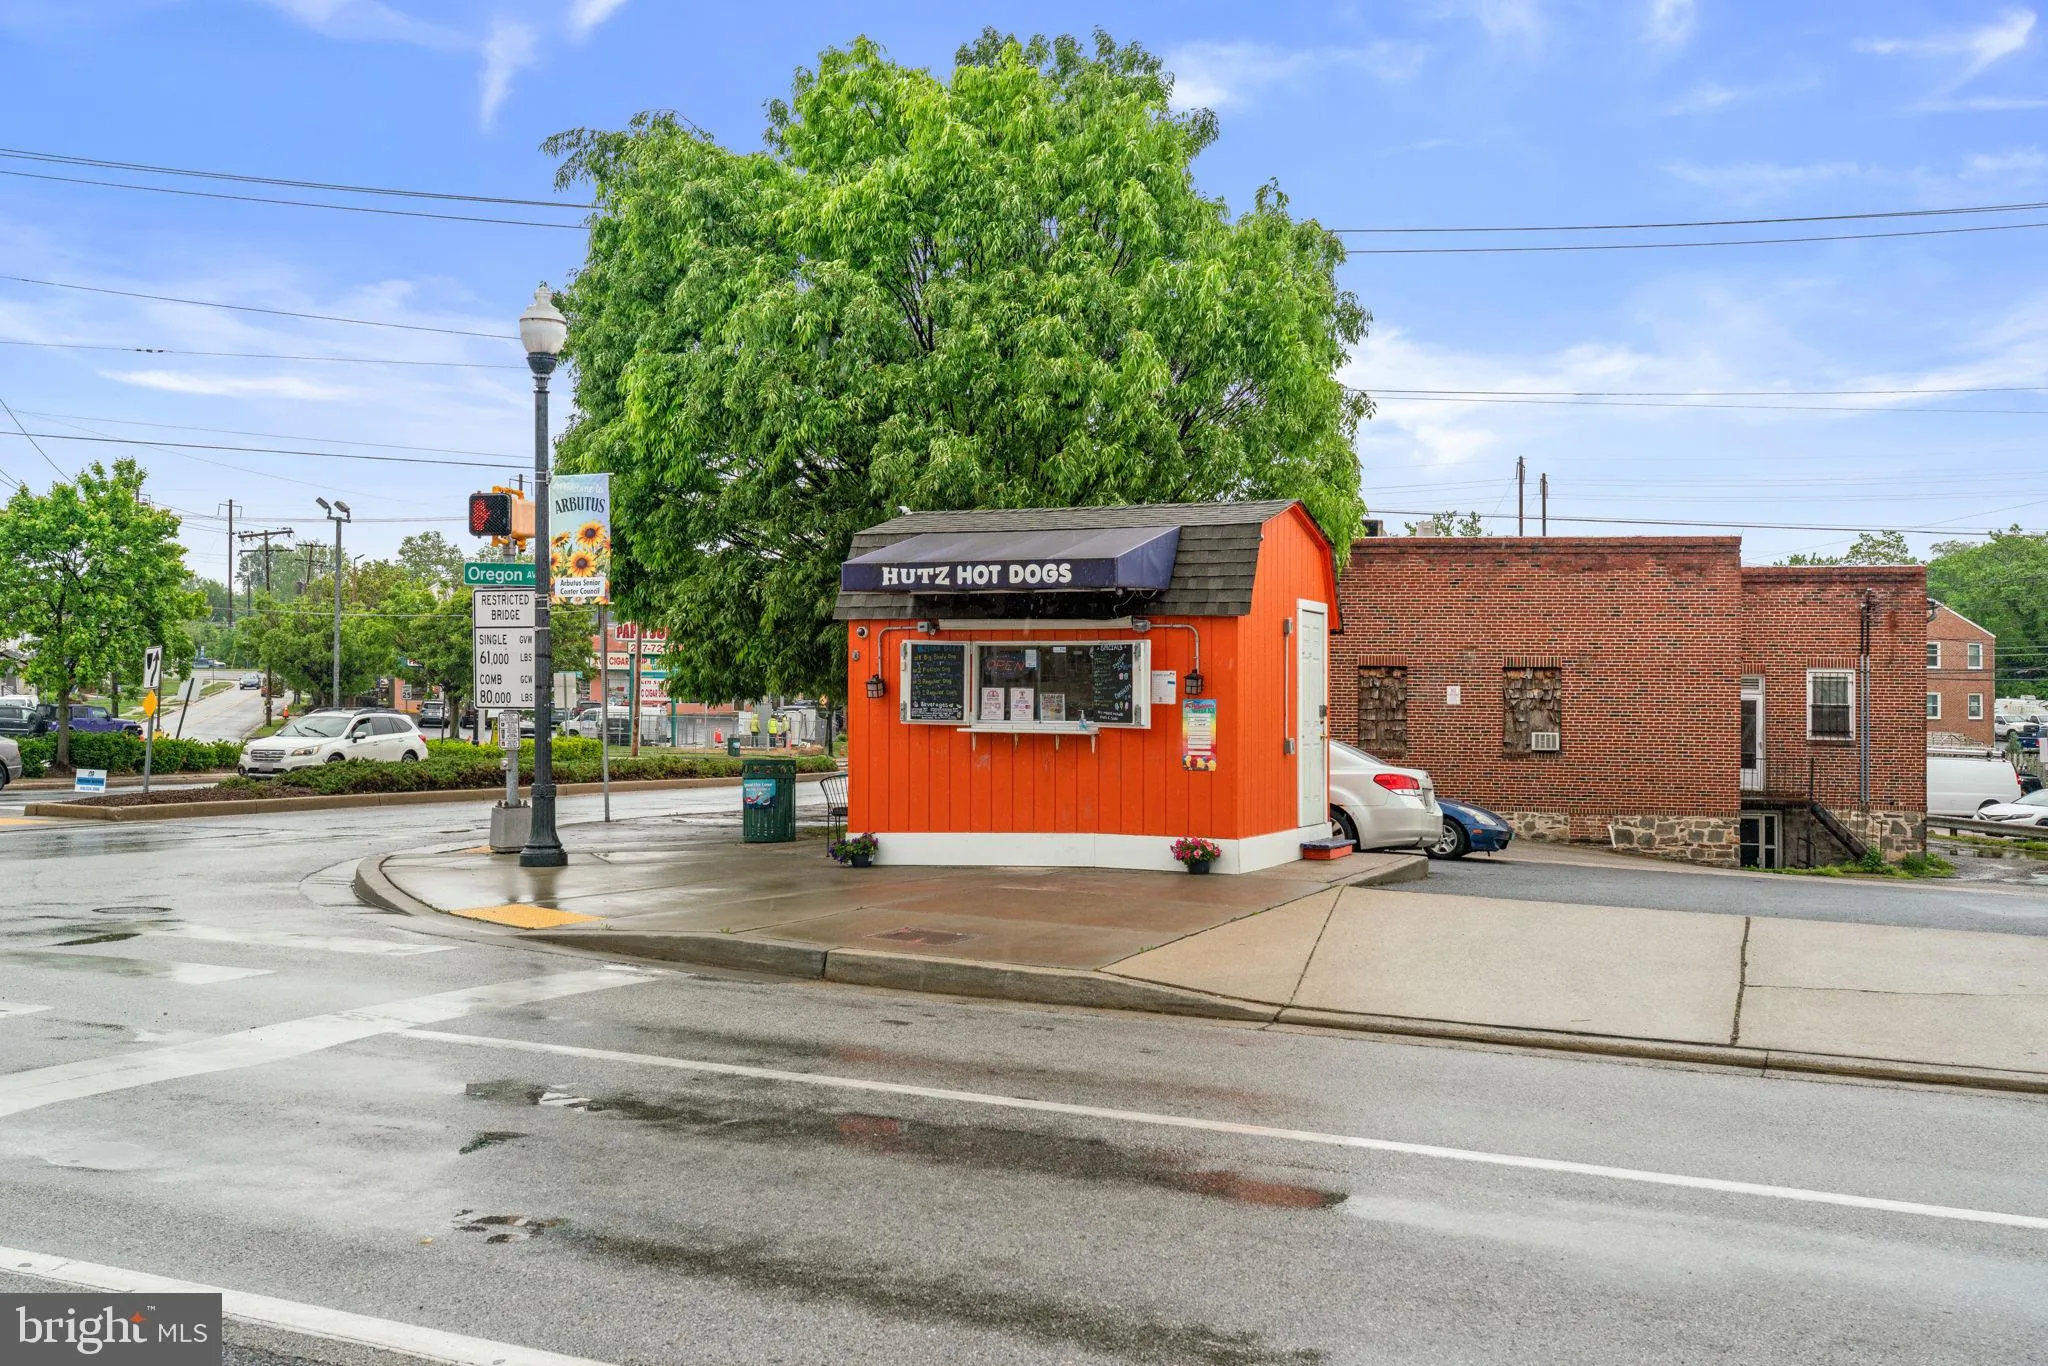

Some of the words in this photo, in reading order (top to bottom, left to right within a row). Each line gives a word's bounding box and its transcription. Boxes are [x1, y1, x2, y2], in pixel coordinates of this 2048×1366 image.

[555, 496, 606, 514] ARBUTUS
[468, 566, 523, 584] Oregon
[882, 566, 950, 586] HUTZ
[957, 565, 1002, 585] HOT
[1009, 563, 1072, 584] DOGS
[580, 587, 600, 595] Council
[481, 594, 530, 606] RESTRICTED
[491, 610, 520, 620] BRIDGE
[616, 624, 648, 638] PAP
[480, 634, 508, 645] SINGLE
[520, 636, 532, 644] GVW
[480, 650, 510, 666] 61,000
[520, 653, 532, 662] LBS
[608, 656, 629, 666] CIGAR
[986, 660, 1024, 671] OPEN
[480, 674, 502, 684] COMB
[480, 690, 512, 705] 80,000
[520, 693, 533, 702] LBS
